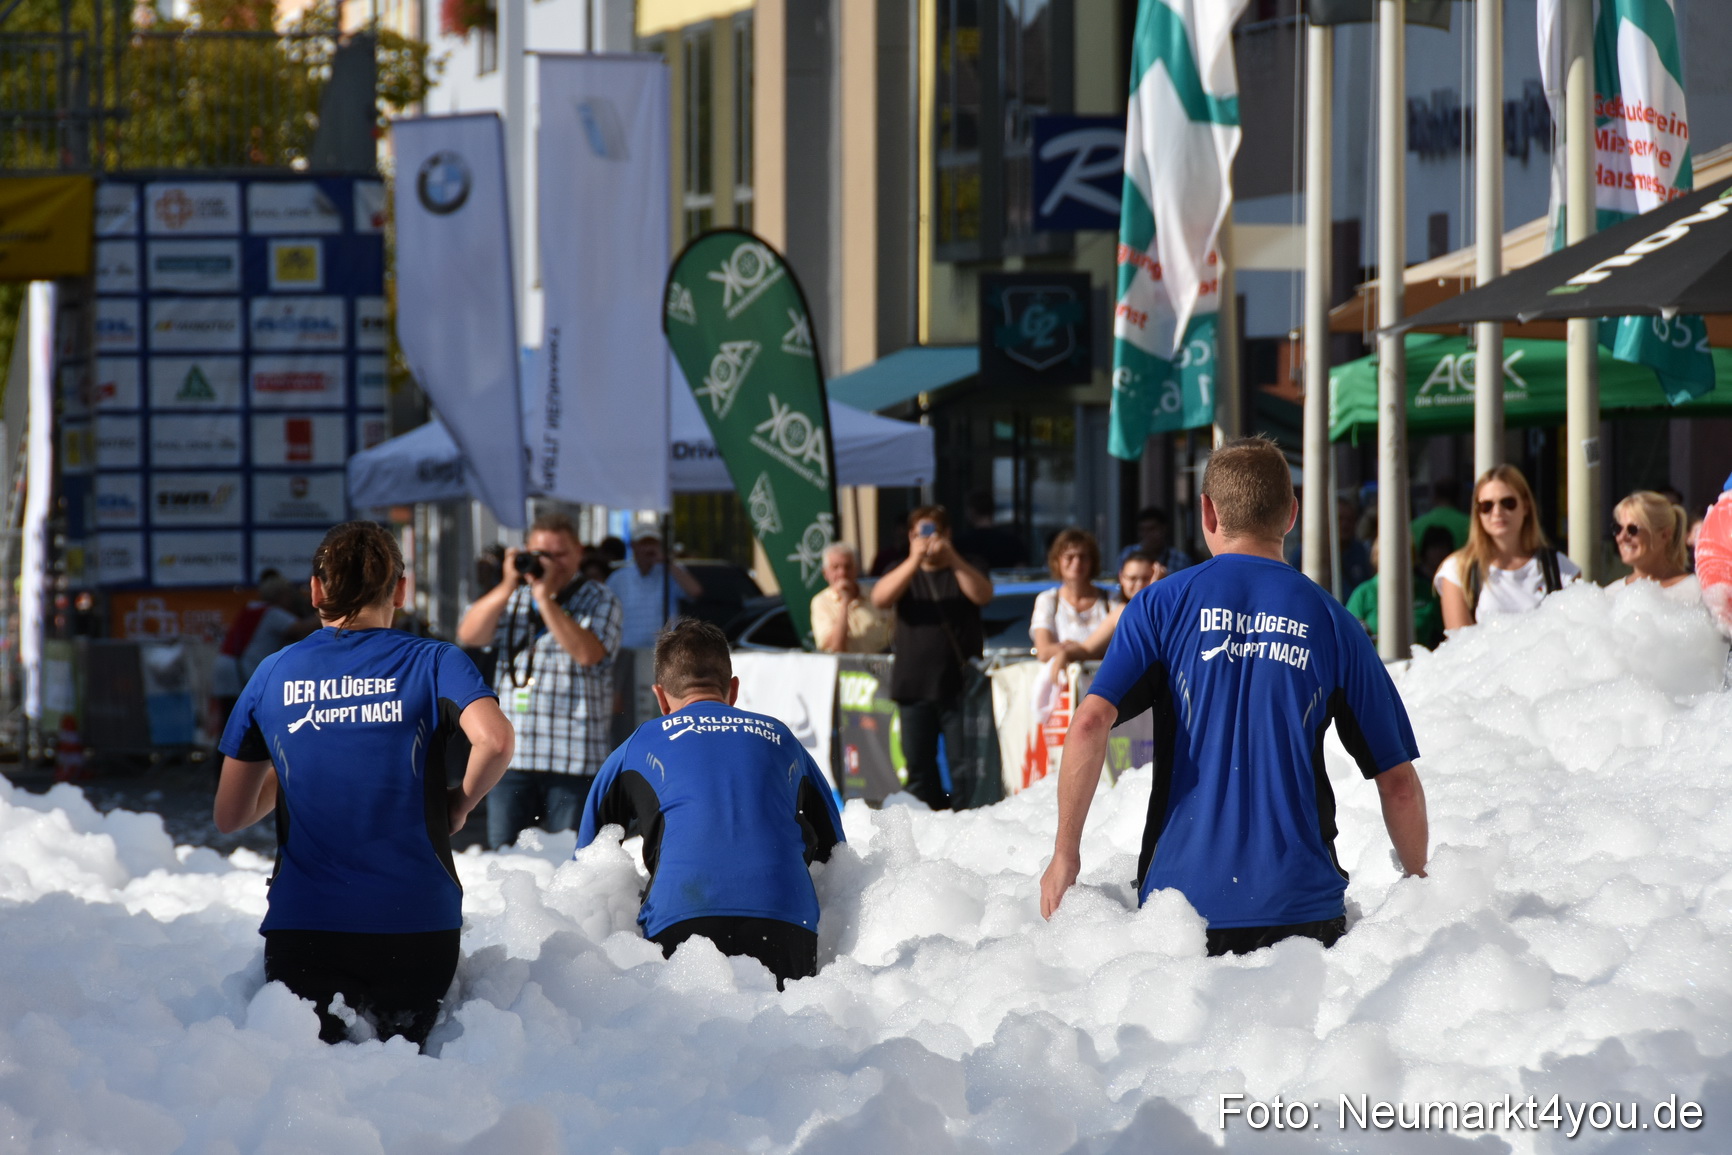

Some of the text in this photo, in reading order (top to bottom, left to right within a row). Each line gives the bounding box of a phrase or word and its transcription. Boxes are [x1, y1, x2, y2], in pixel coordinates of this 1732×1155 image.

[1200, 608, 1309, 639] DER KLÜGERE
[1230, 641, 1310, 671] KIPPT NACH
[283, 675, 397, 706] DER KLÜGERE
[315, 699, 403, 723] KIPPT NACH
[661, 715, 775, 731] DER KLÜGERE
[744, 725, 781, 746] NACH
